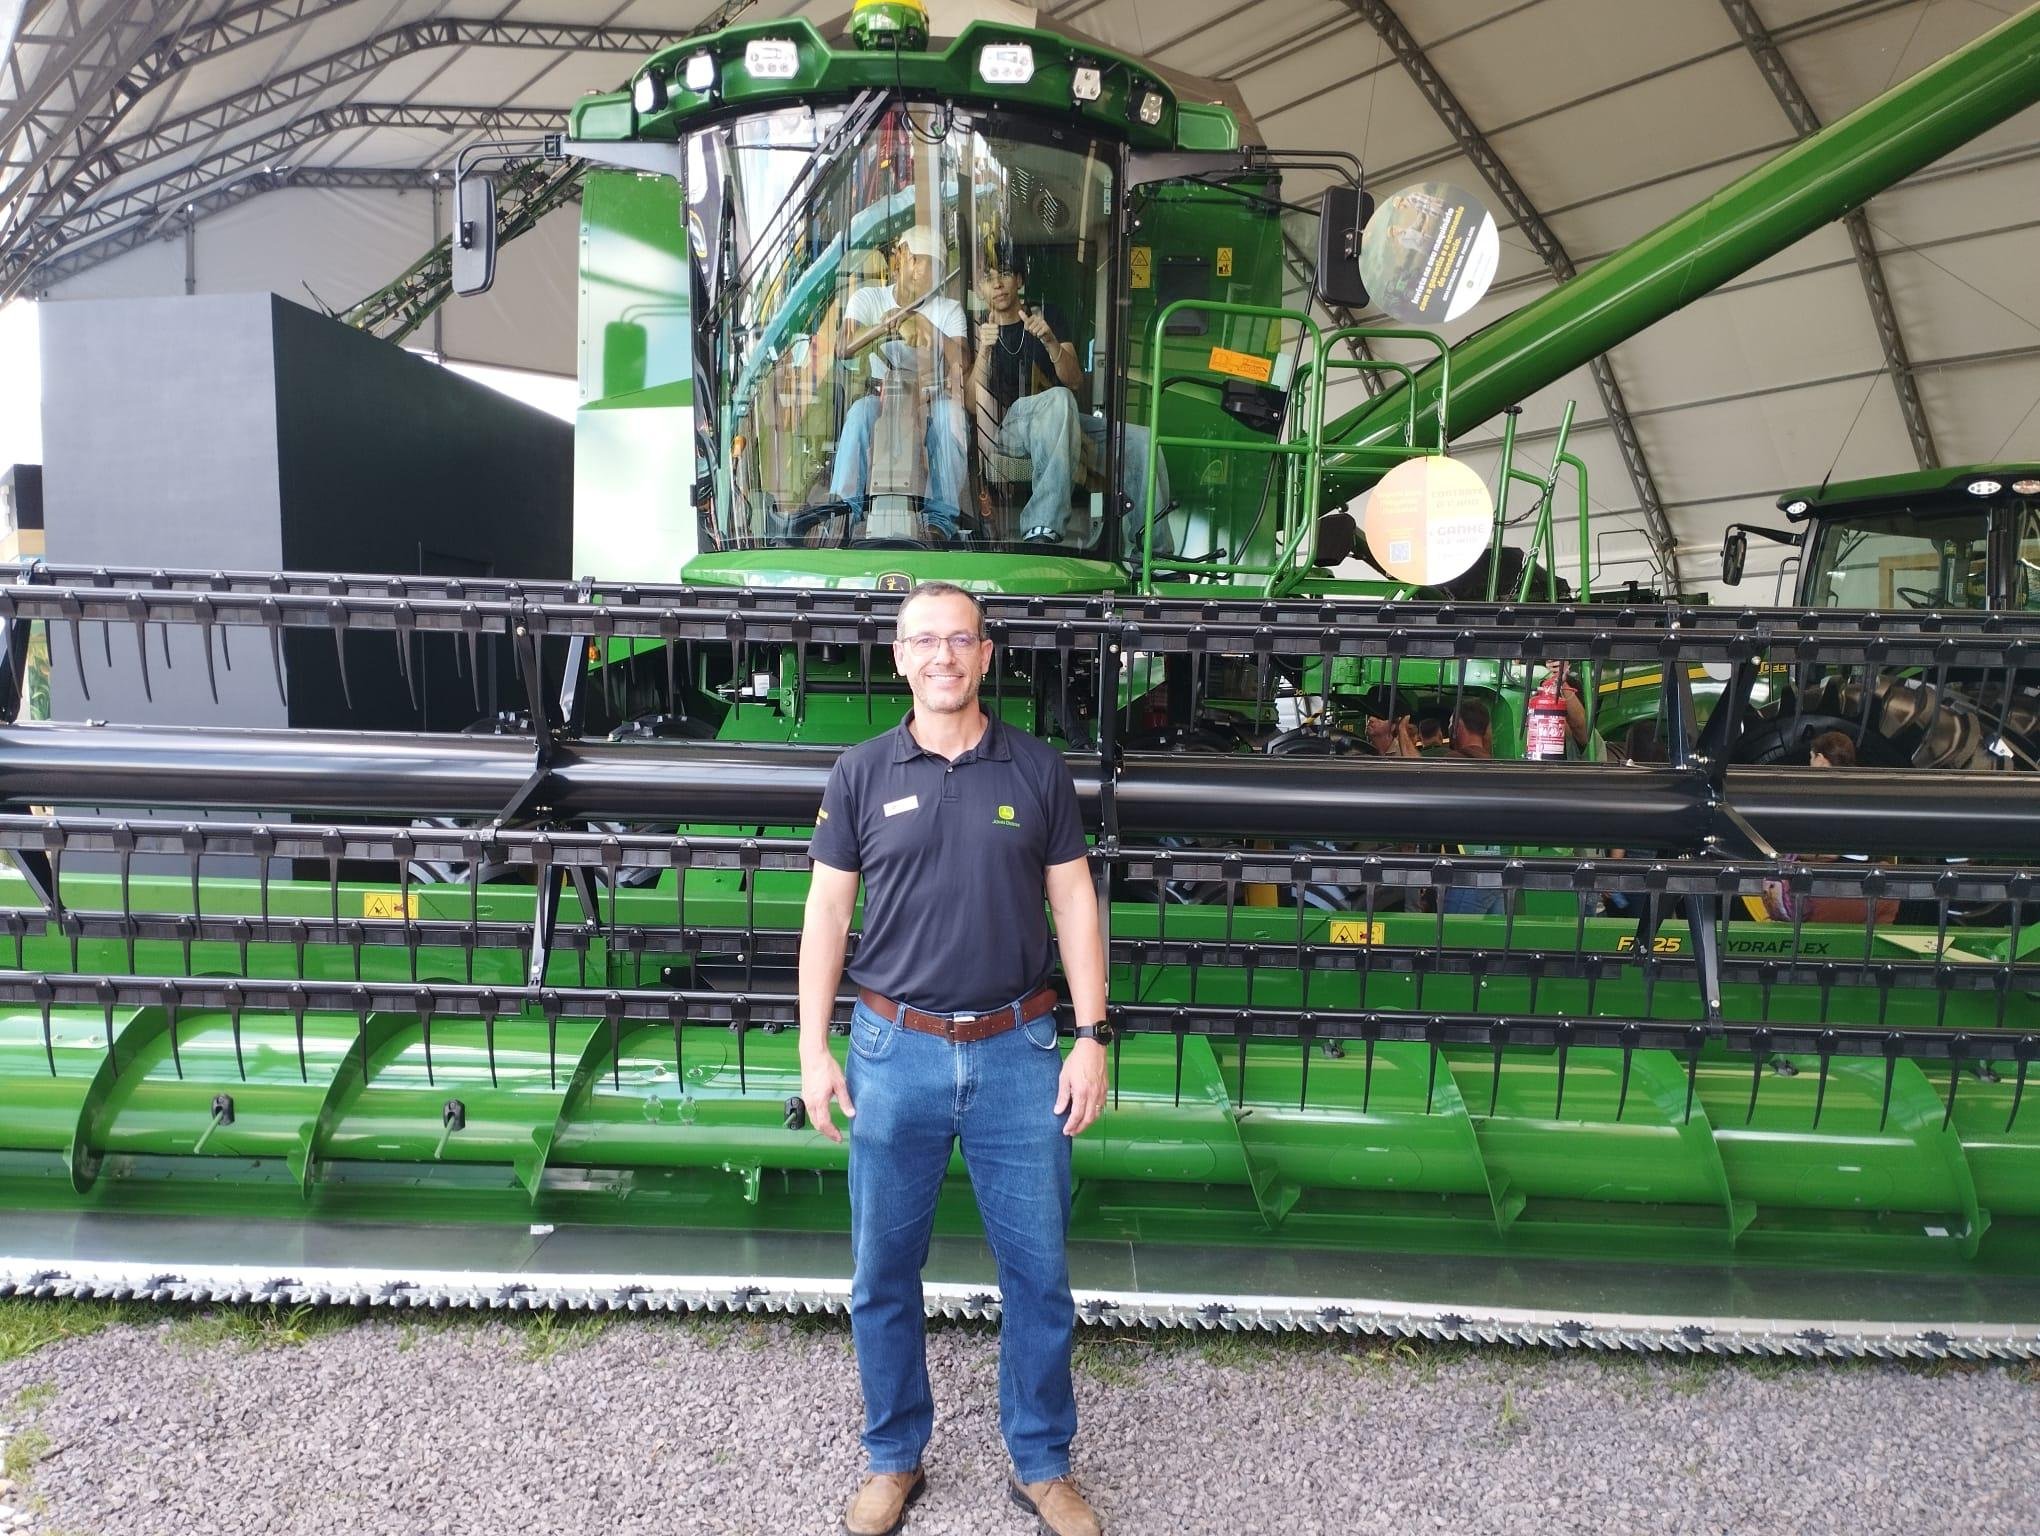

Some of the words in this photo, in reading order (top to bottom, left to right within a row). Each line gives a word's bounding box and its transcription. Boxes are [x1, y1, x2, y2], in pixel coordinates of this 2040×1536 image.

[1411, 275, 1425, 304] Invista
[1427, 251, 1437, 265] seu
[1433, 207, 1455, 252] maquinário
[1419, 293, 1429, 311] com
[1427, 255, 1445, 288] garantia
[1445, 205, 1464, 244] economia
[1437, 524, 1486, 536] GANHE
[1616, 936, 1682, 952] F25
[1715, 939, 1830, 955] YDRAFEX
